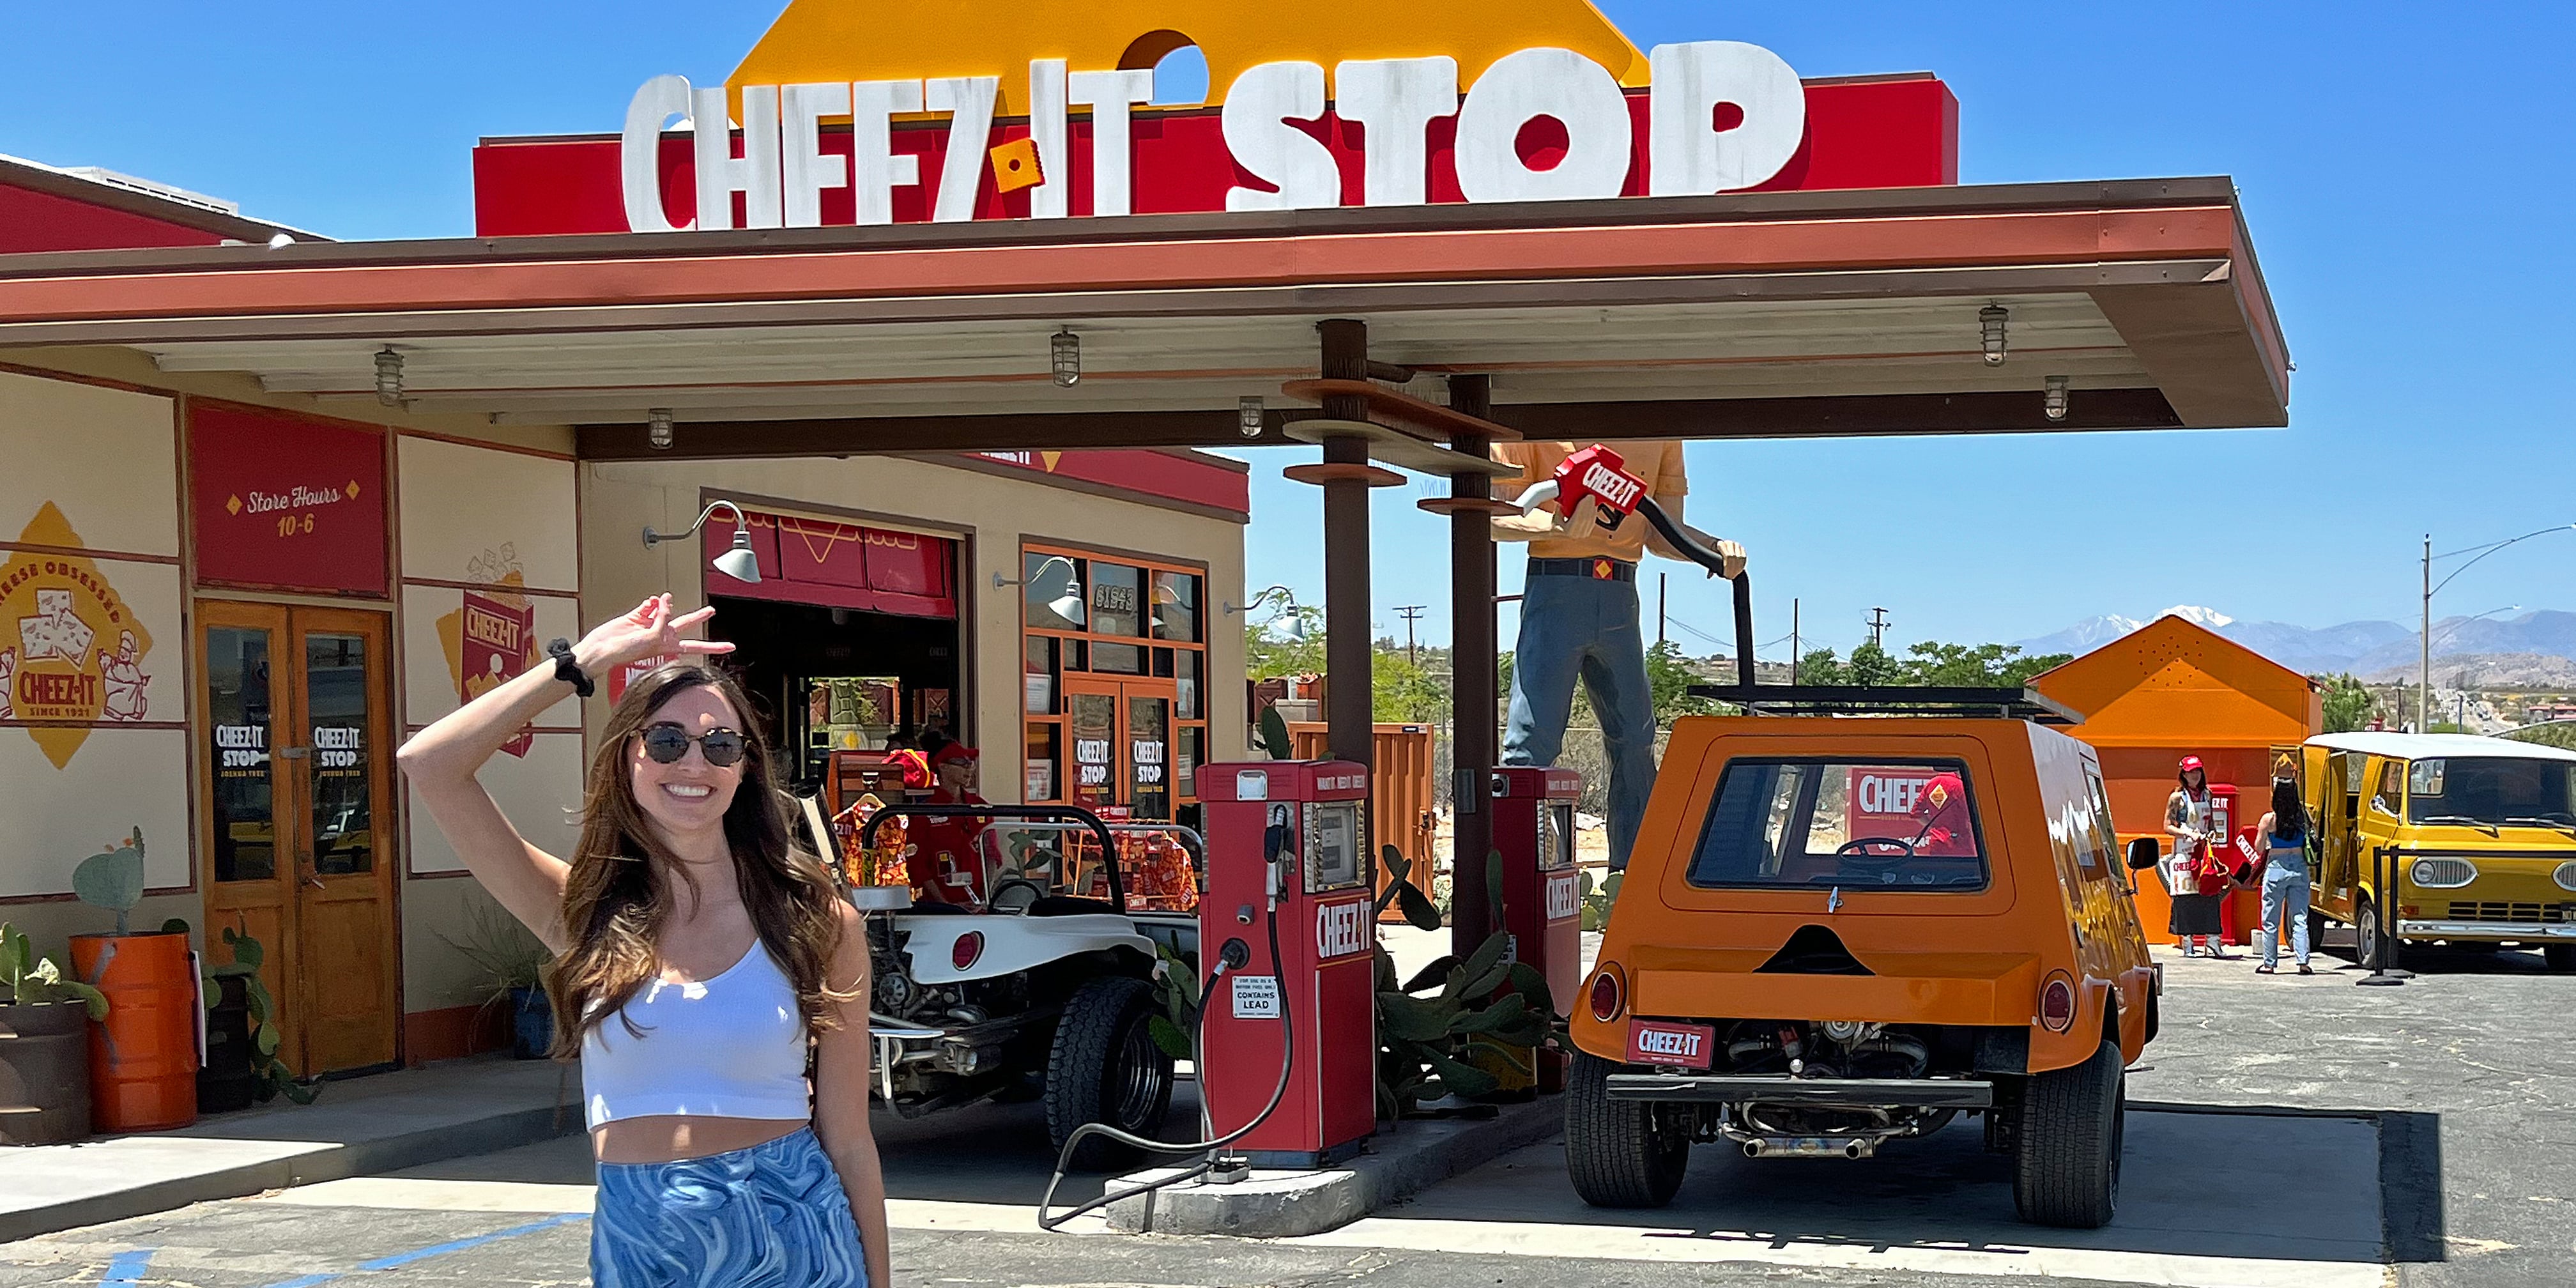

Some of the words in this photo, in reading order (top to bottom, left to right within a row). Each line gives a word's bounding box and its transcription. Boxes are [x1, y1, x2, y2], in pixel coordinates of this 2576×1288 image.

[1222, 40, 1805, 212] STOP
[247, 491, 288, 514] Store
[291, 486, 341, 508] Hours
[277, 513, 314, 537] 10-6
[45, 561, 120, 624] OBSESSED
[1095, 584, 1134, 611] 61943
[30, 708, 61, 716] SINCE
[223, 750, 260, 767] STOP
[321, 751, 356, 767] STOP
[1081, 765, 1106, 783] STOP
[1138, 765, 1162, 783] STOP
[1859, 775, 1930, 813] CHEE
[1243, 1000, 1269, 1009] LEAD
